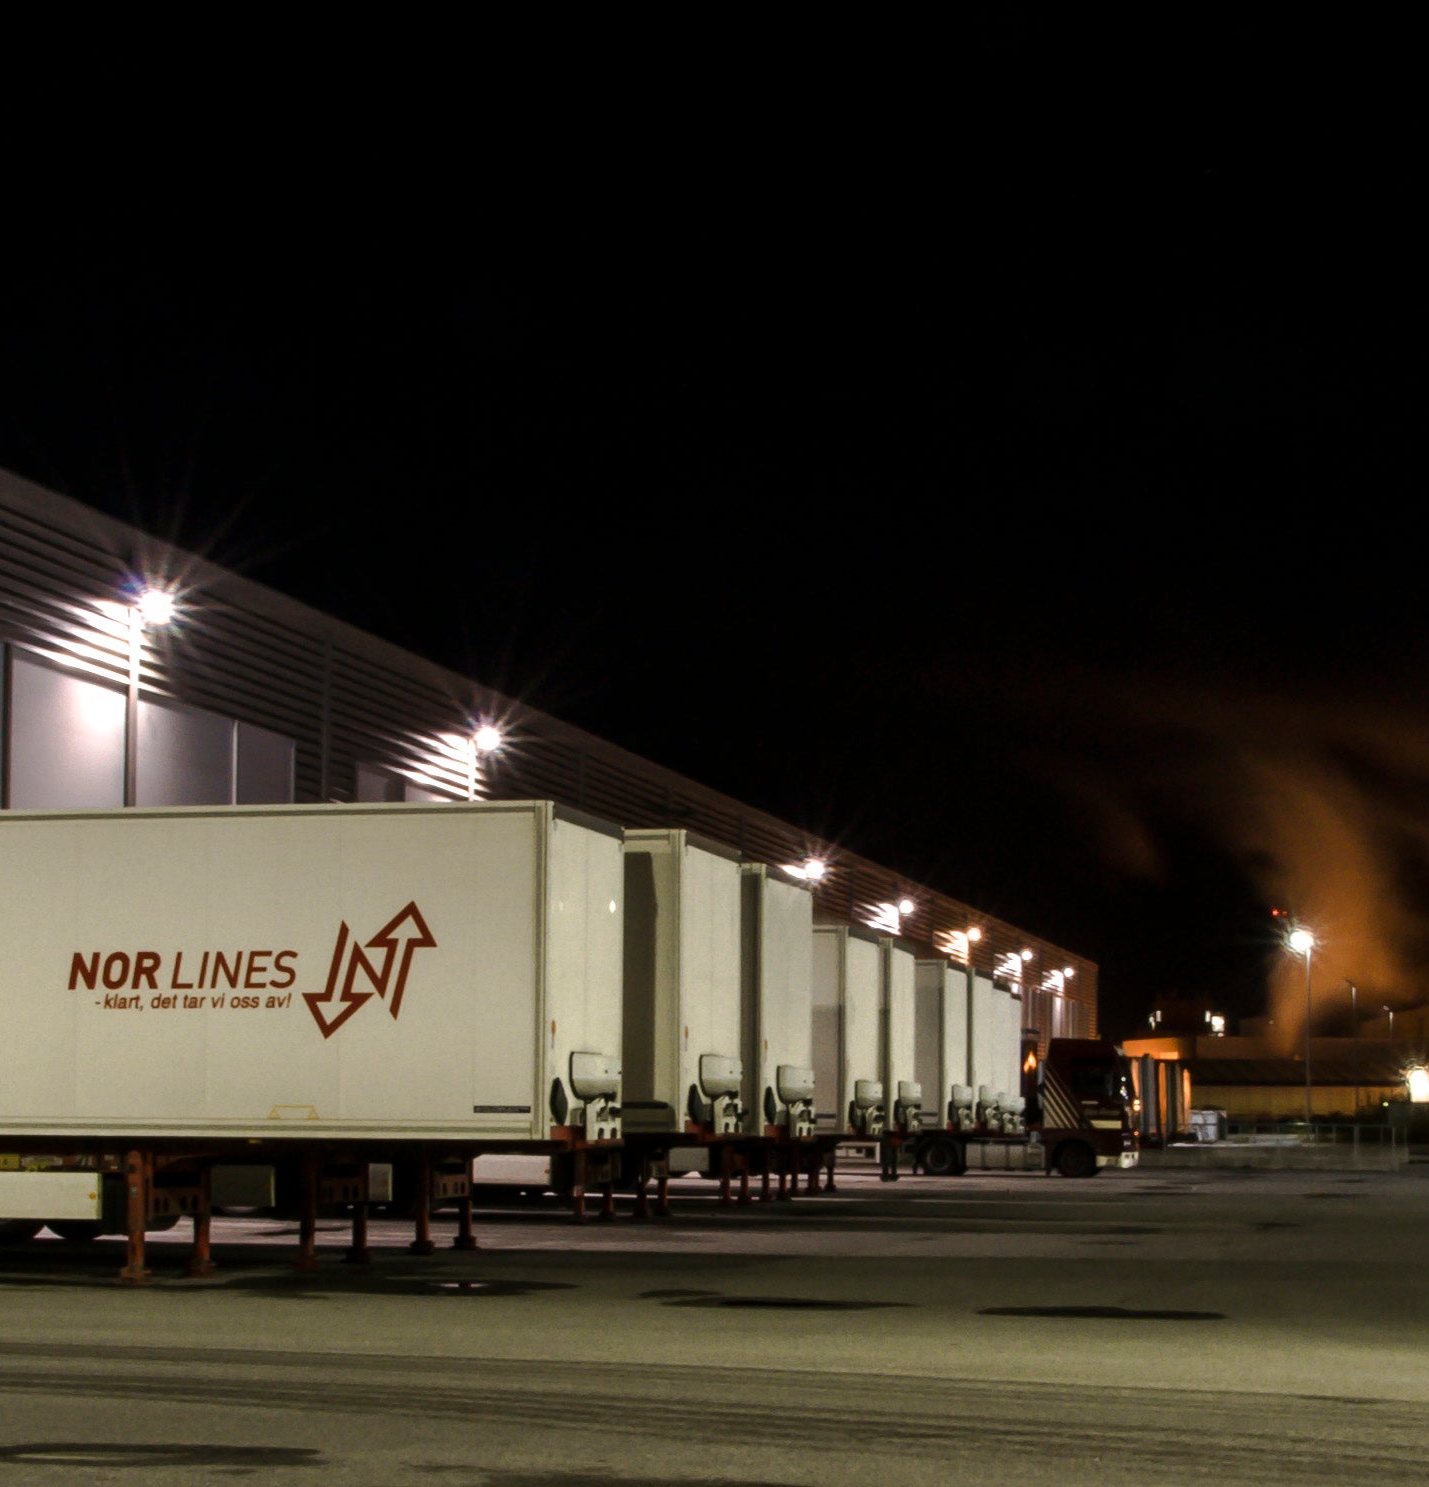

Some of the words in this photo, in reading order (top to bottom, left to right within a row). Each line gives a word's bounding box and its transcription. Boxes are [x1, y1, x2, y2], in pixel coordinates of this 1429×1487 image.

[68, 951, 162, 990] NOR
[171, 950, 299, 989] LINES
[150, 993, 178, 1009] det
[183, 995, 206, 1009] tar
[211, 993, 226, 1009] vi
[230, 997, 261, 1009] oss
[265, 993, 294, 1009] av!
